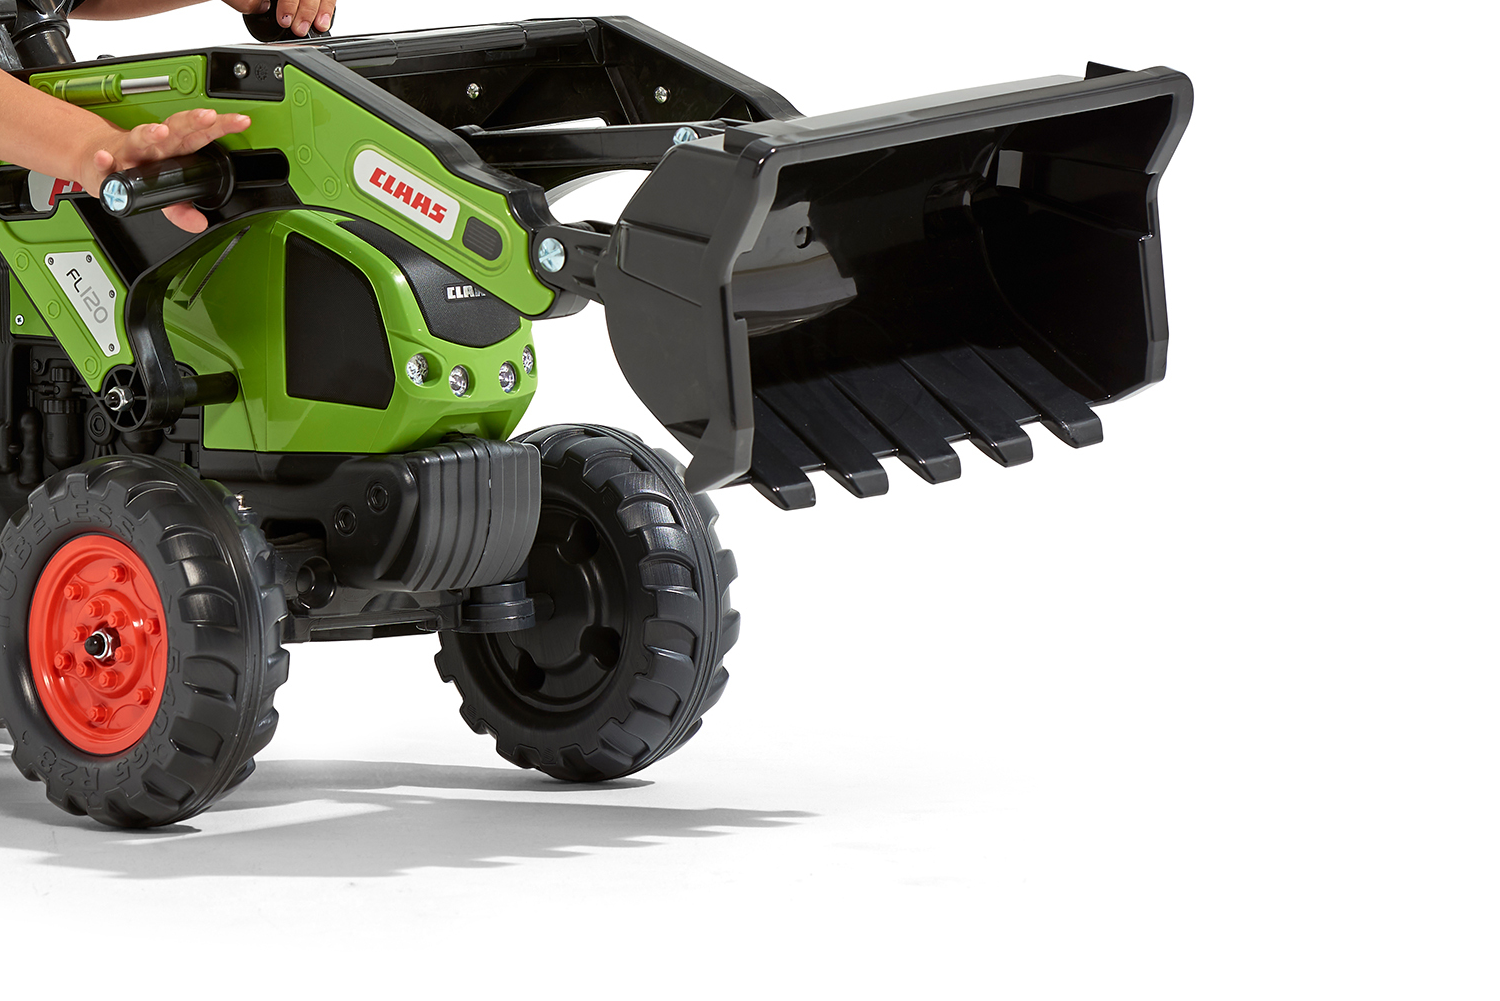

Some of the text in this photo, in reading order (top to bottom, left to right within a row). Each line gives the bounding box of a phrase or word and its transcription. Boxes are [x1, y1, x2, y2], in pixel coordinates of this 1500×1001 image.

[369, 167, 447, 224] CLAAS
[66, 268, 109, 324] FL120
[446, 285, 486, 299] CLA
[40, 746, 100, 791] R28
